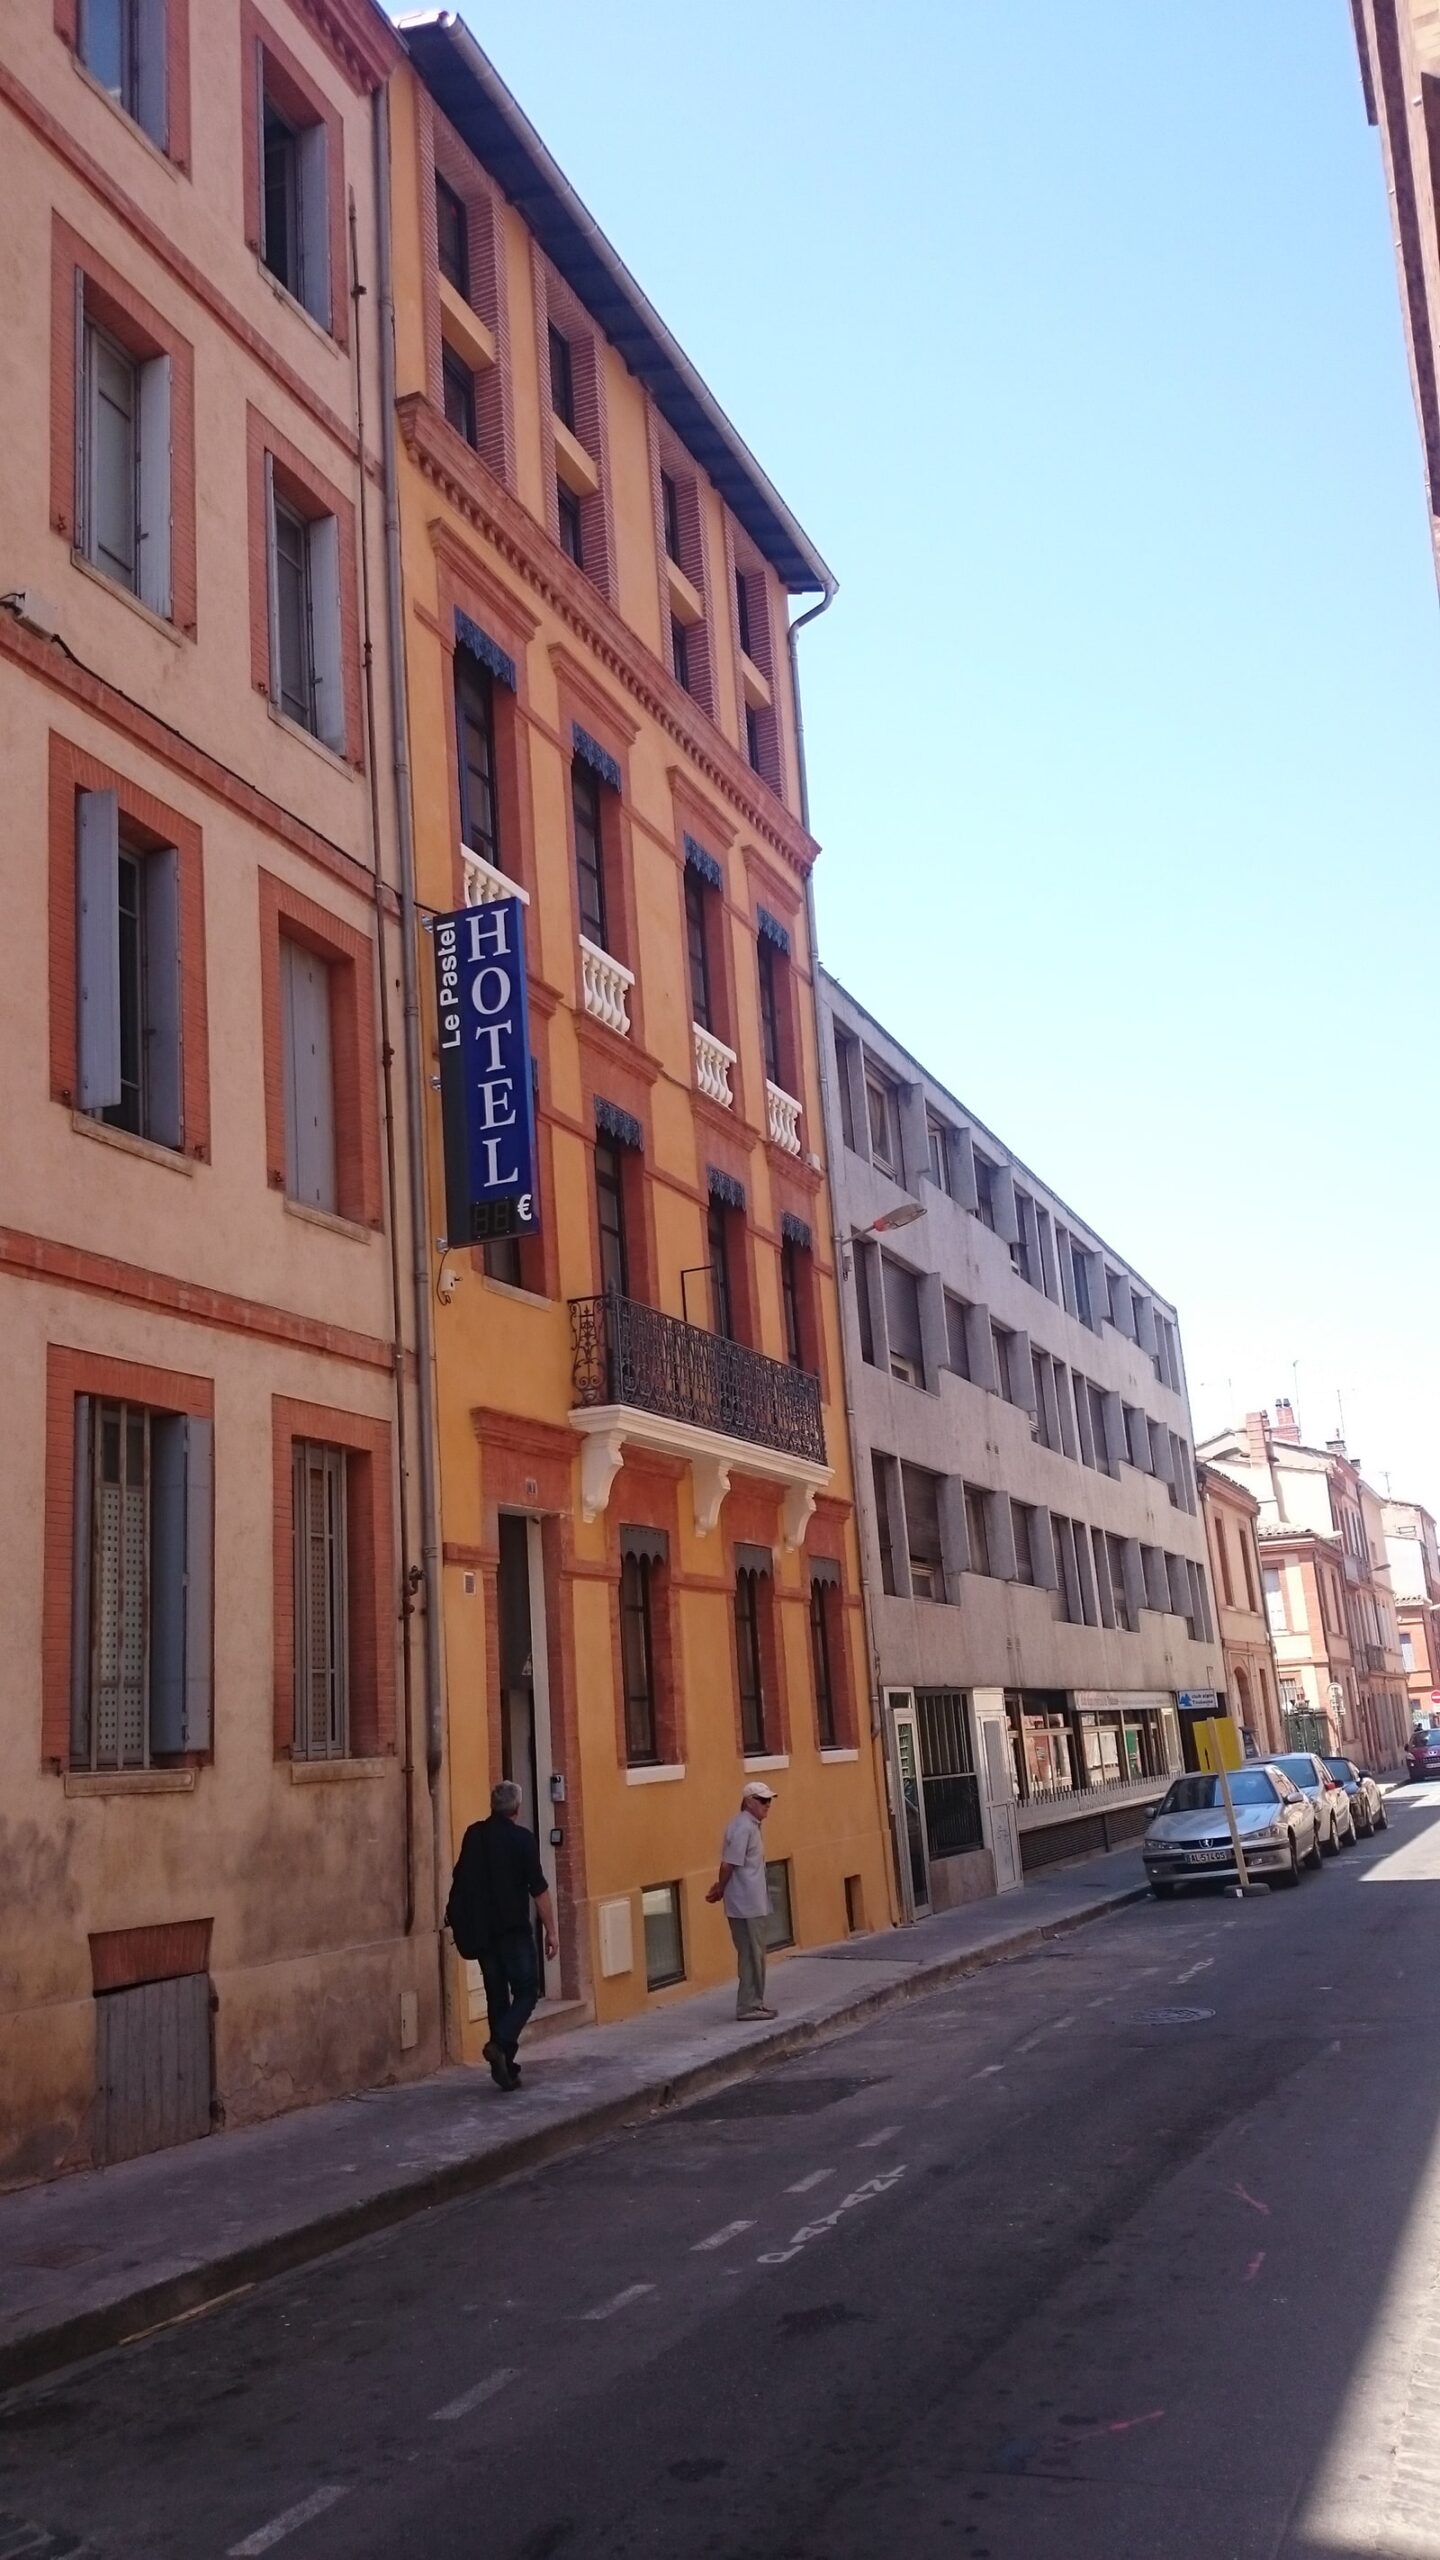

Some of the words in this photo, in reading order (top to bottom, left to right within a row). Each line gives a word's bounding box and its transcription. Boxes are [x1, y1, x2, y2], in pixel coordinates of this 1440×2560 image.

[436, 921, 459, 1007] Pastel
[442, 1014, 461, 1049] Le
[465, 907, 519, 1188] HOTEL
[517, 1193, 532, 1221] €
[756, 2164, 909, 2264] PAYANT
